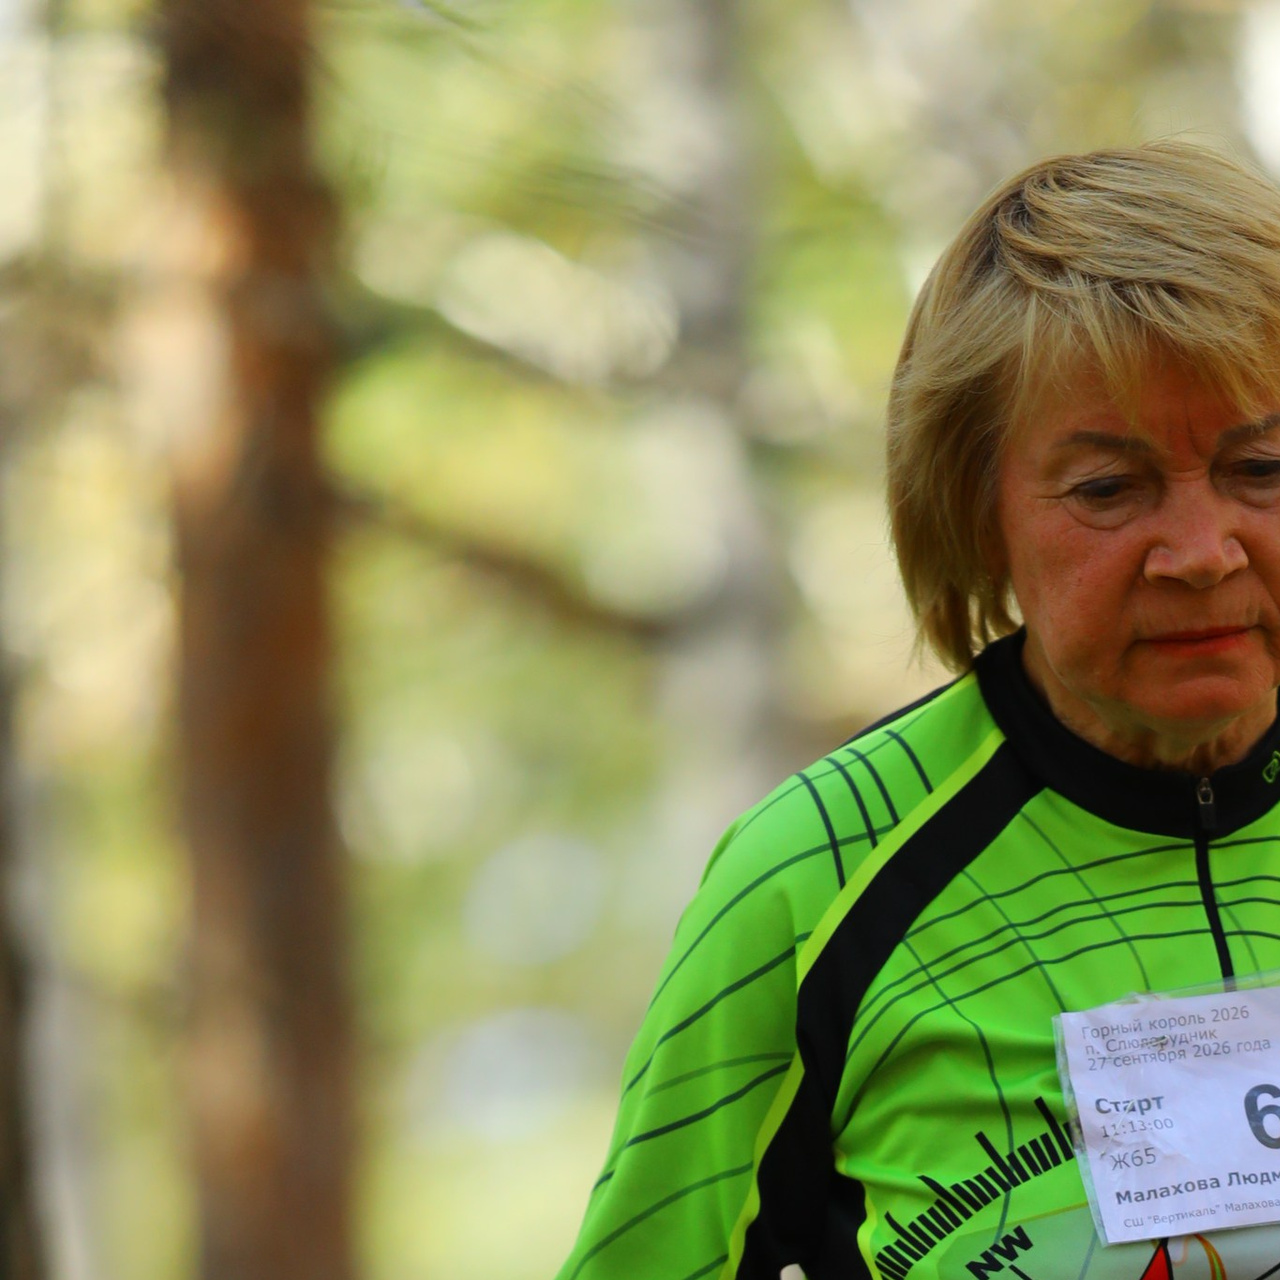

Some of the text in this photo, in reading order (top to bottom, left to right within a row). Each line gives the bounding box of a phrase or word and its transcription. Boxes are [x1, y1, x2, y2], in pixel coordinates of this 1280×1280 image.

[1082, 1005, 1249, 1039] Горный король 2026
[1086, 1045, 1100, 1055] п.
[1088, 1038, 1271, 1071] 27 сентября 2026 года
[1095, 1096, 1164, 1116] Старт
[1101, 1118, 1174, 1138] 11:13:00
[1110, 1147, 1156, 1171] Ж65
[1115, 1177, 1221, 1205] Малахова
